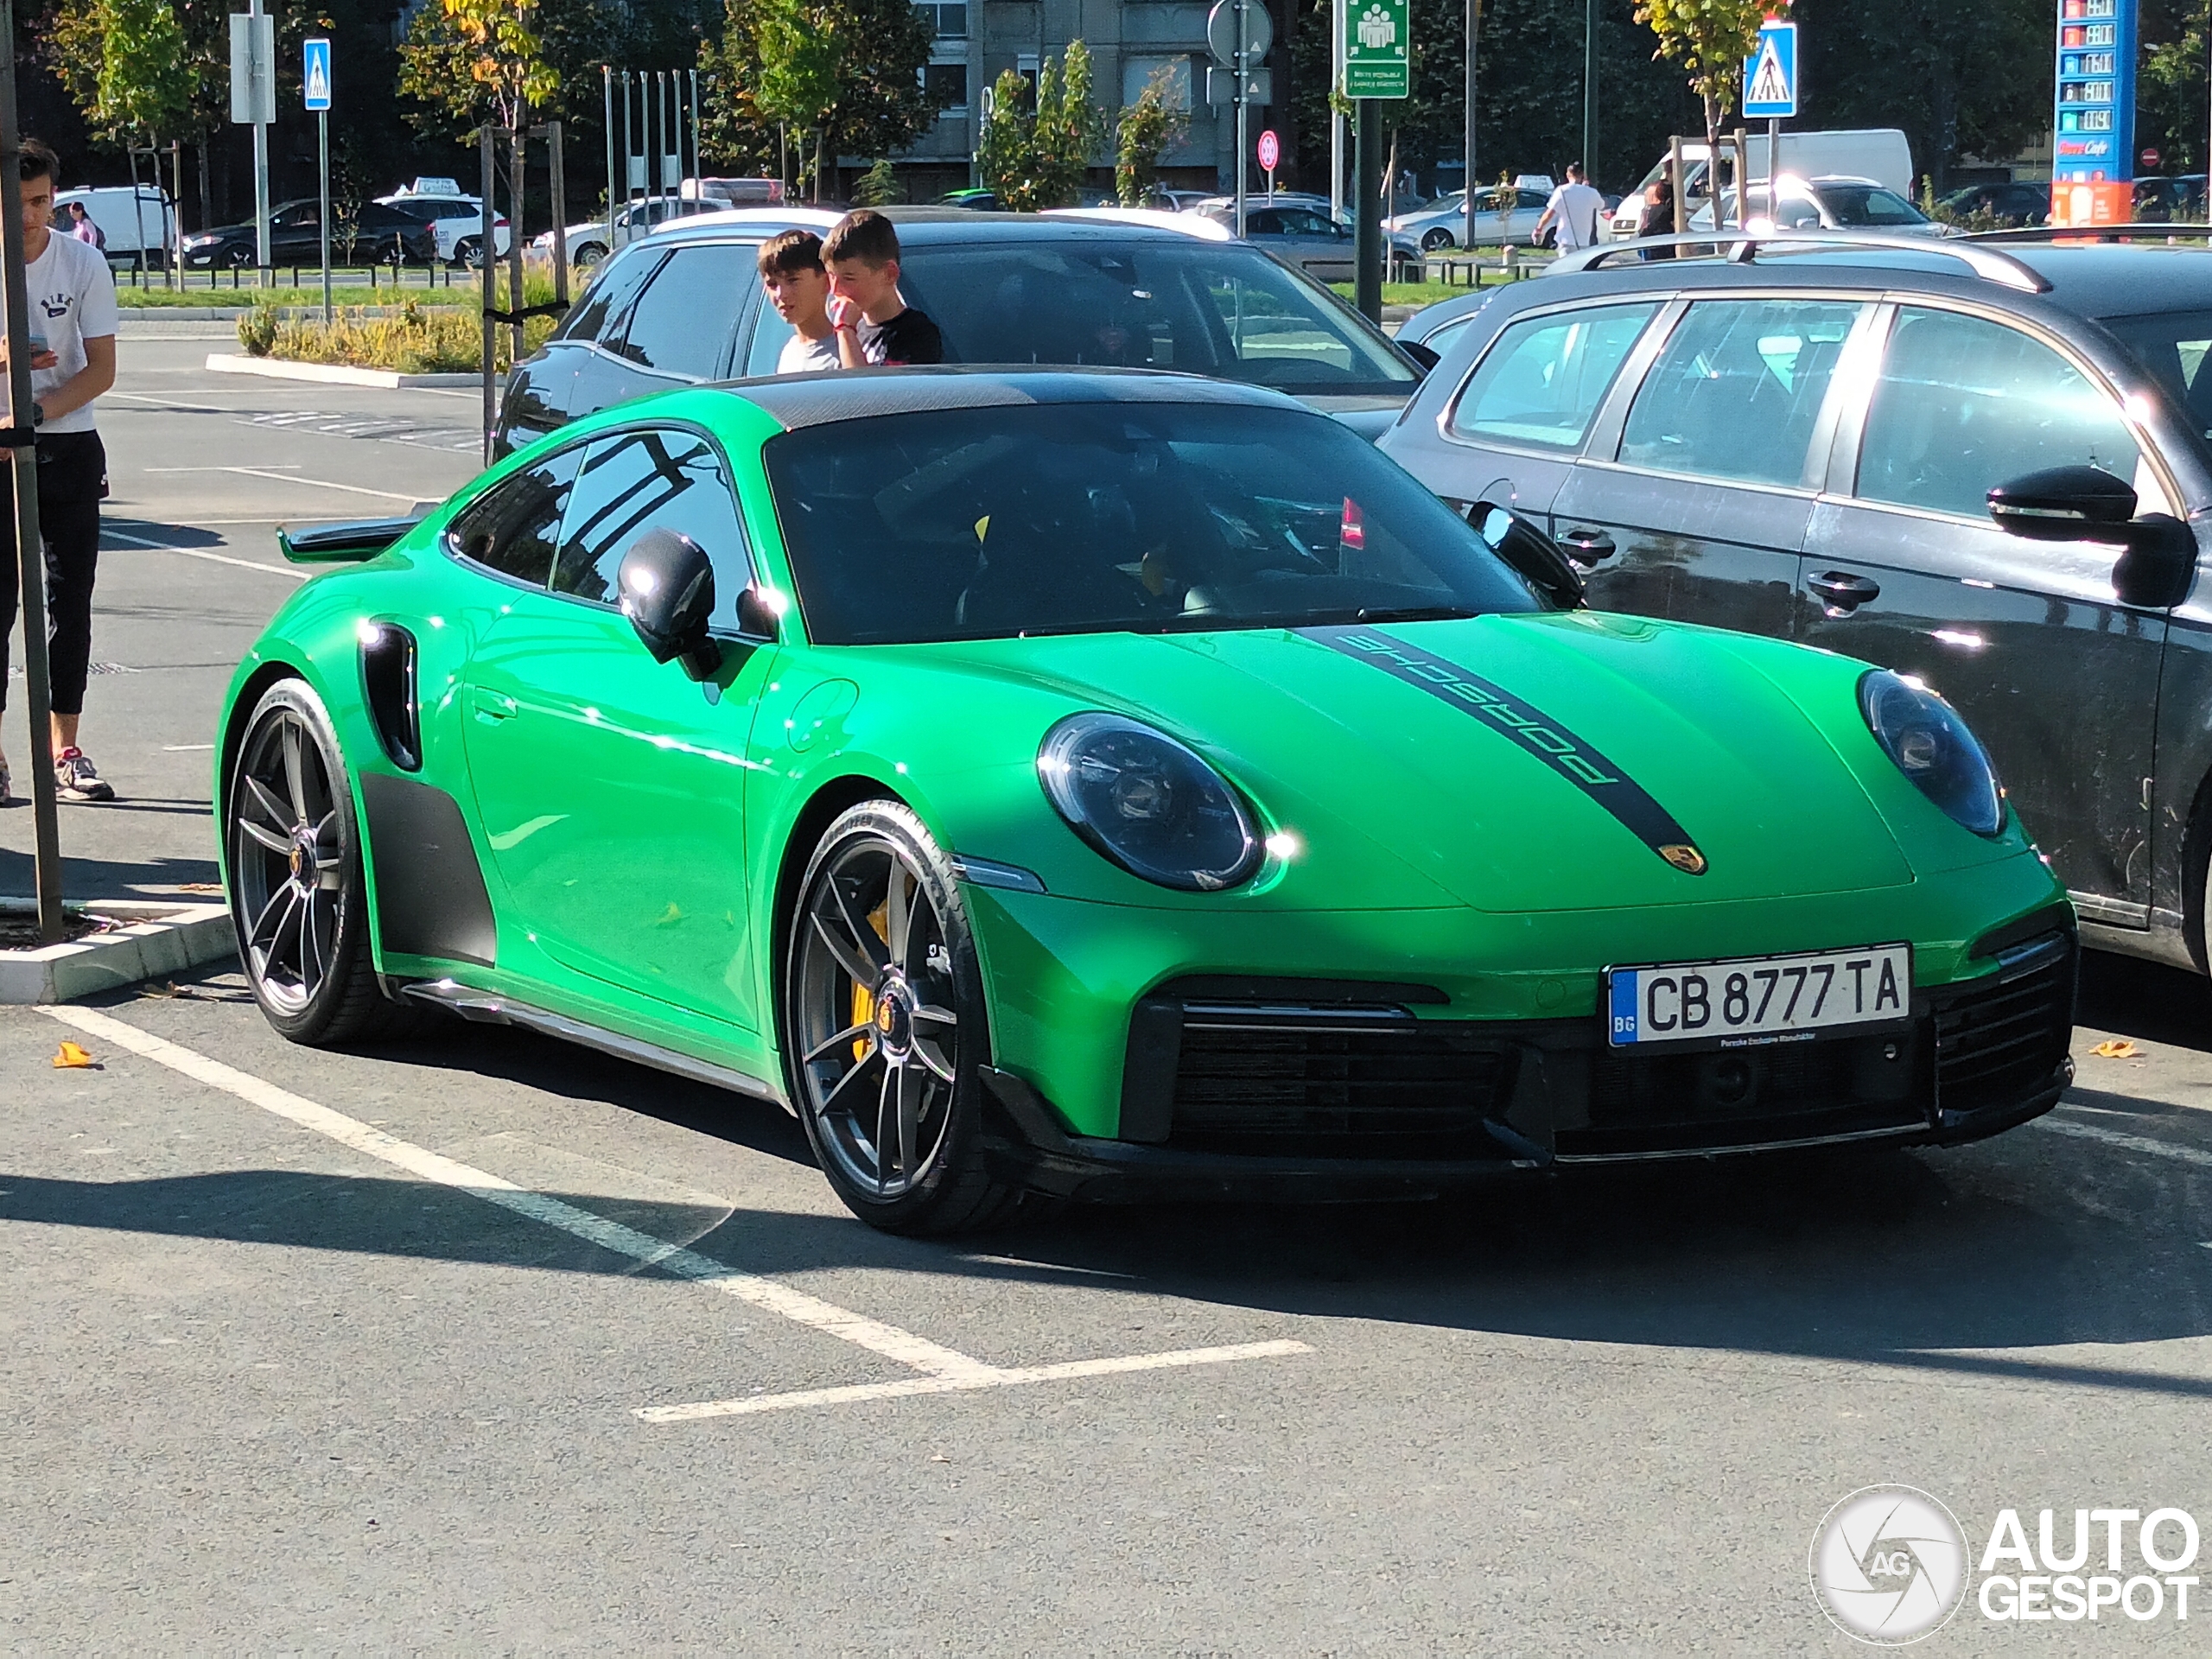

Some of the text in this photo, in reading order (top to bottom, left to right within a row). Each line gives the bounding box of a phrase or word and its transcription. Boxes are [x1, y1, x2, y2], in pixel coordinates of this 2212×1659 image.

[1336, 635, 1619, 785] PORSCHE
[1613, 1016, 1636, 1033] BG
[1647, 957, 1900, 1032] CB 8777 TA
